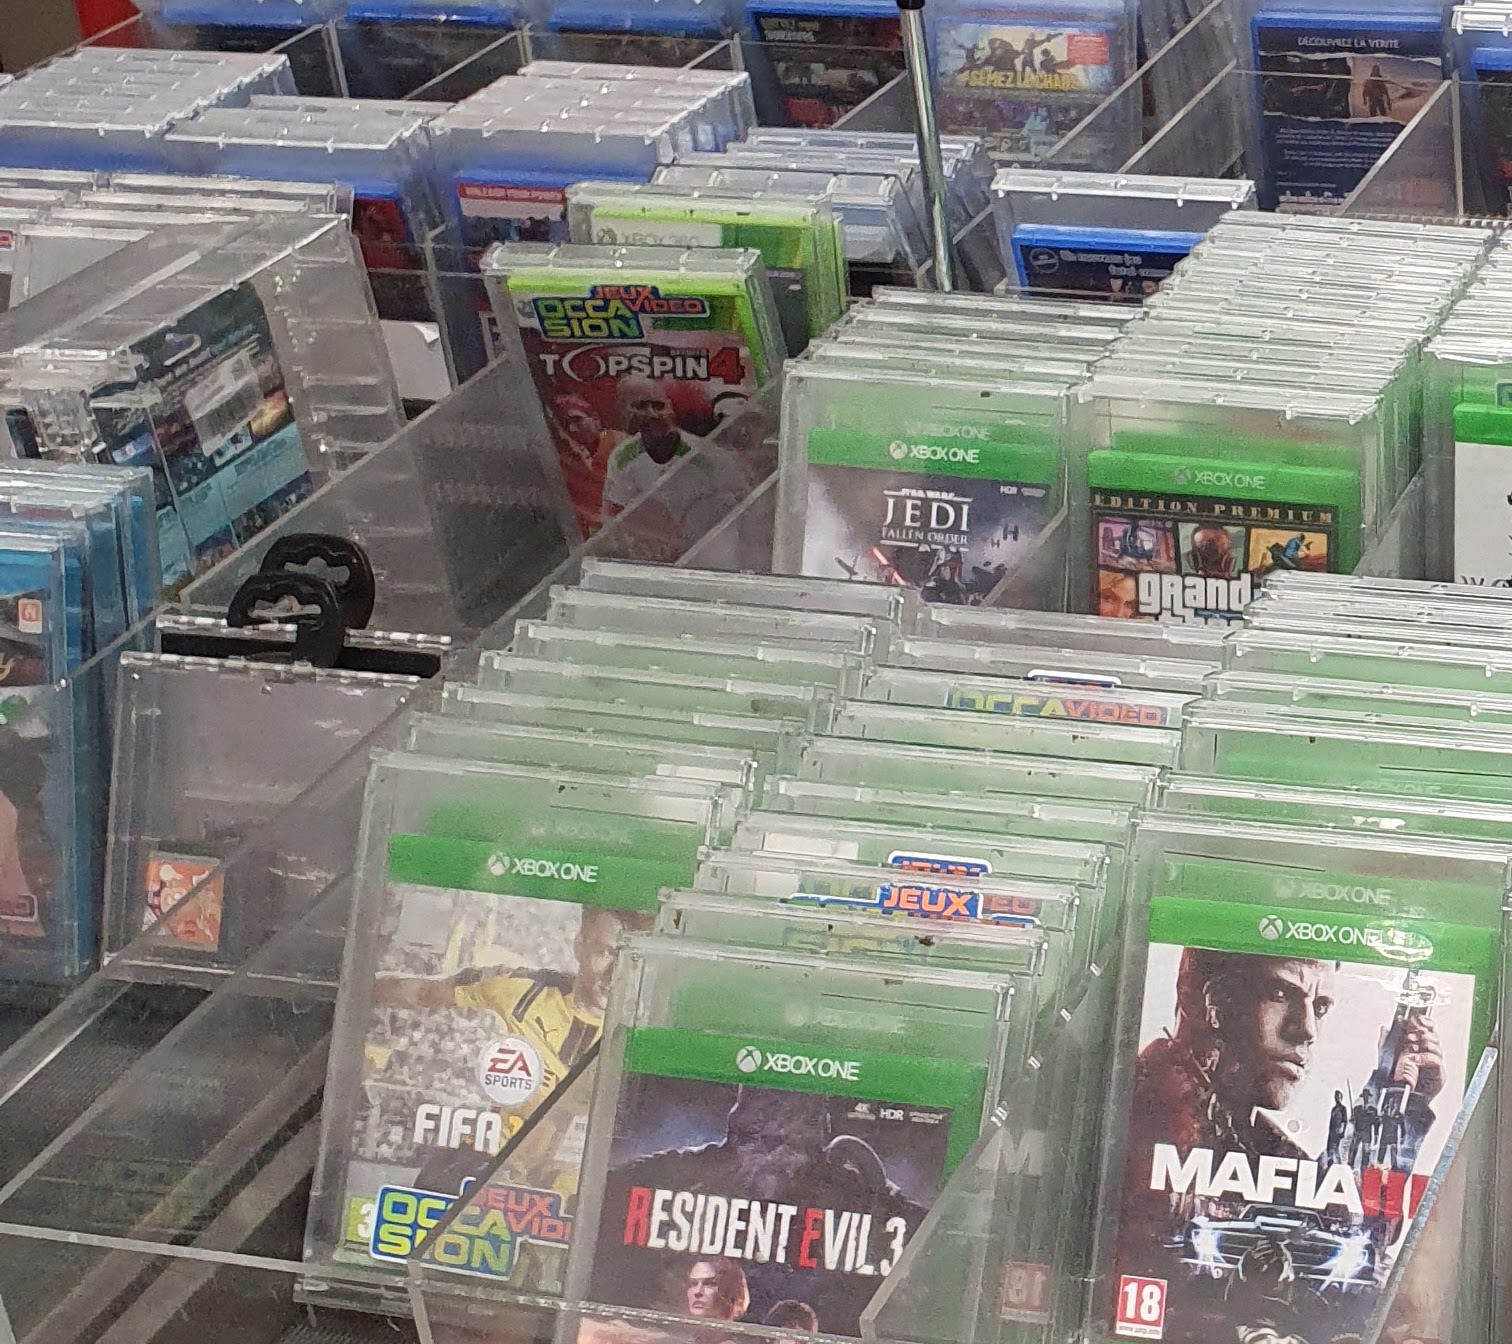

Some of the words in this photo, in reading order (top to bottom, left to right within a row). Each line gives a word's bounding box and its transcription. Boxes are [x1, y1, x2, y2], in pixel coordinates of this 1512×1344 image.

[536, 296, 634, 319] OCCA
[624, 298, 702, 314] VIDEO
[545, 318, 640, 339] SION
[540, 344, 708, 381] TOPSPIN
[908, 443, 948, 461] XBOX
[948, 447, 980, 464] ONE
[1194, 470, 1232, 486] XBOX
[1233, 473, 1266, 490] ONE
[883, 497, 970, 532] JEDI
[1093, 493, 1199, 514] EDITION
[1213, 503, 1334, 524] PREMIUM
[881, 527, 924, 541] FALLEN
[927, 530, 969, 545] ORDER
[512, 857, 559, 879] XBOX
[560, 863, 599, 883] ONE
[884, 885, 974, 917] JEUX
[1351, 886, 1392, 905] ONE
[1285, 920, 1337, 943] XBOX
[488, 1048, 534, 1076] EA
[763, 1052, 816, 1076] XBOX
[817, 1058, 861, 1081] ONE
[485, 1073, 534, 1092] SPORTS
[414, 1103, 500, 1156] FIFA
[1150, 1142, 1364, 1217] MAFIA
[623, 1185, 797, 1267] RESIDENT
[799, 1206, 875, 1278] EVIL
[879, 1216, 907, 1278] 3
[1123, 1281, 1162, 1322] 18
